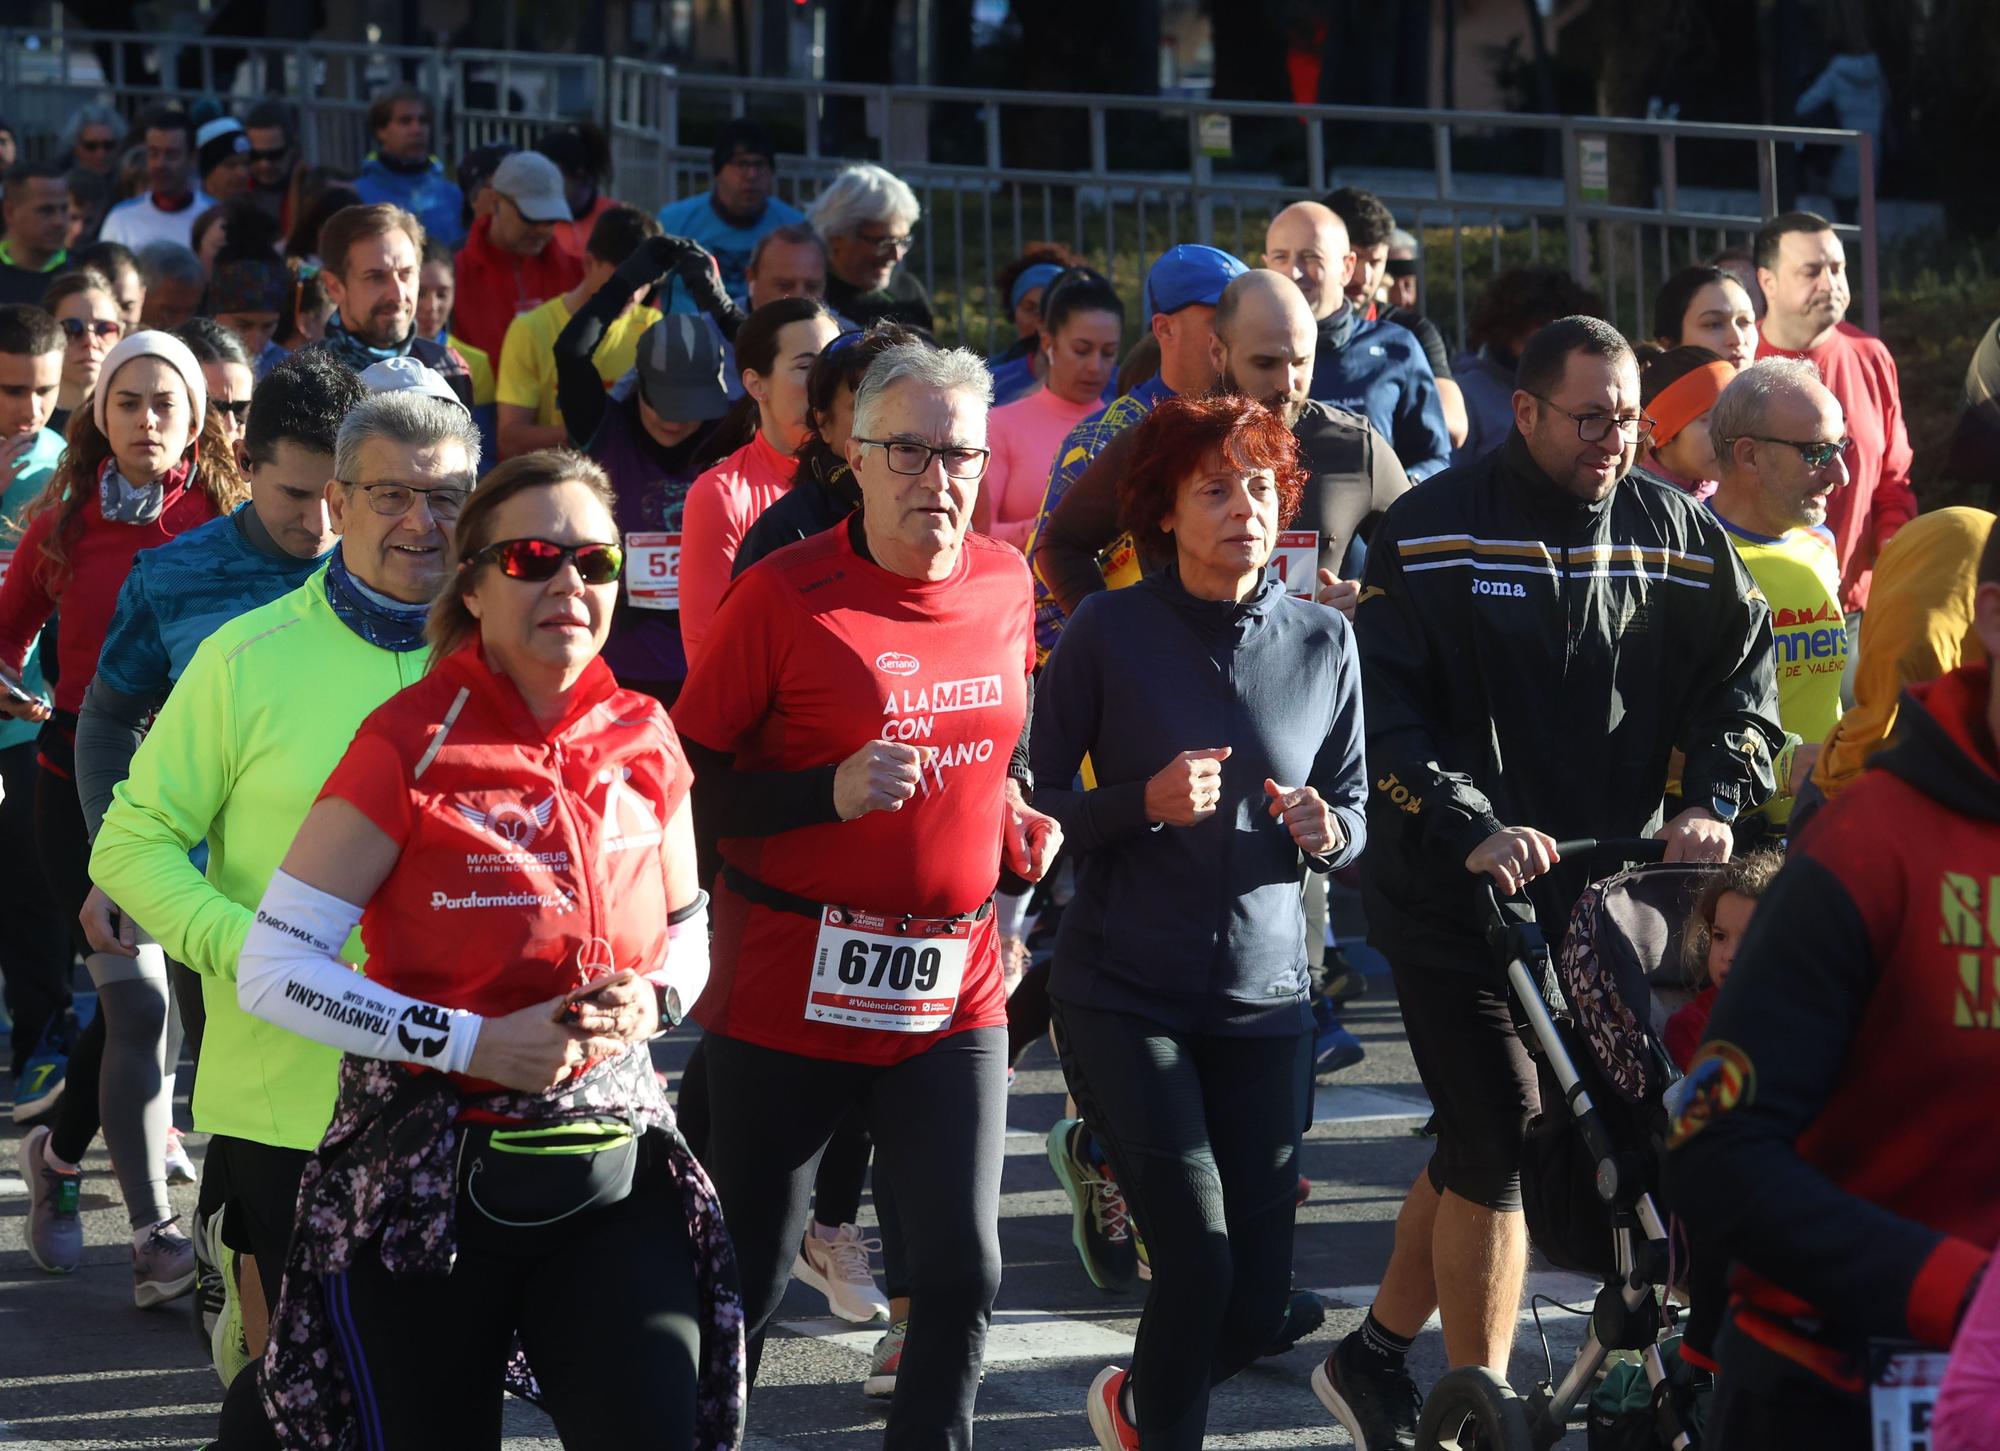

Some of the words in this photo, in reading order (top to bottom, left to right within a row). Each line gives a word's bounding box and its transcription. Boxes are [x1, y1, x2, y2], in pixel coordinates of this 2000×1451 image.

[1471, 578, 1526, 598] Joma
[1773, 627, 1848, 663] nners
[880, 657, 916, 669] Serrano
[1785, 665, 1802, 678] DE
[882, 690, 899, 715] A
[903, 687, 930, 713] LA
[935, 679, 1000, 709] META
[881, 715, 934, 741] CON
[466, 852, 525, 865] MARCOS
[467, 864, 520, 874] TRAINING
[431, 890, 538, 911] Parafarmàcia
[288, 926, 314, 944] MAX
[313, 939, 330, 951] TECH
[838, 939, 942, 992] 6709
[285, 979, 391, 1036] TRANSVULCANIA
[342, 990, 366, 1007] ISLAND
[365, 1000, 386, 1014] PALMA
[848, 998, 917, 1013] #ValènciaCorre
[387, 1008, 397, 1017] LA
